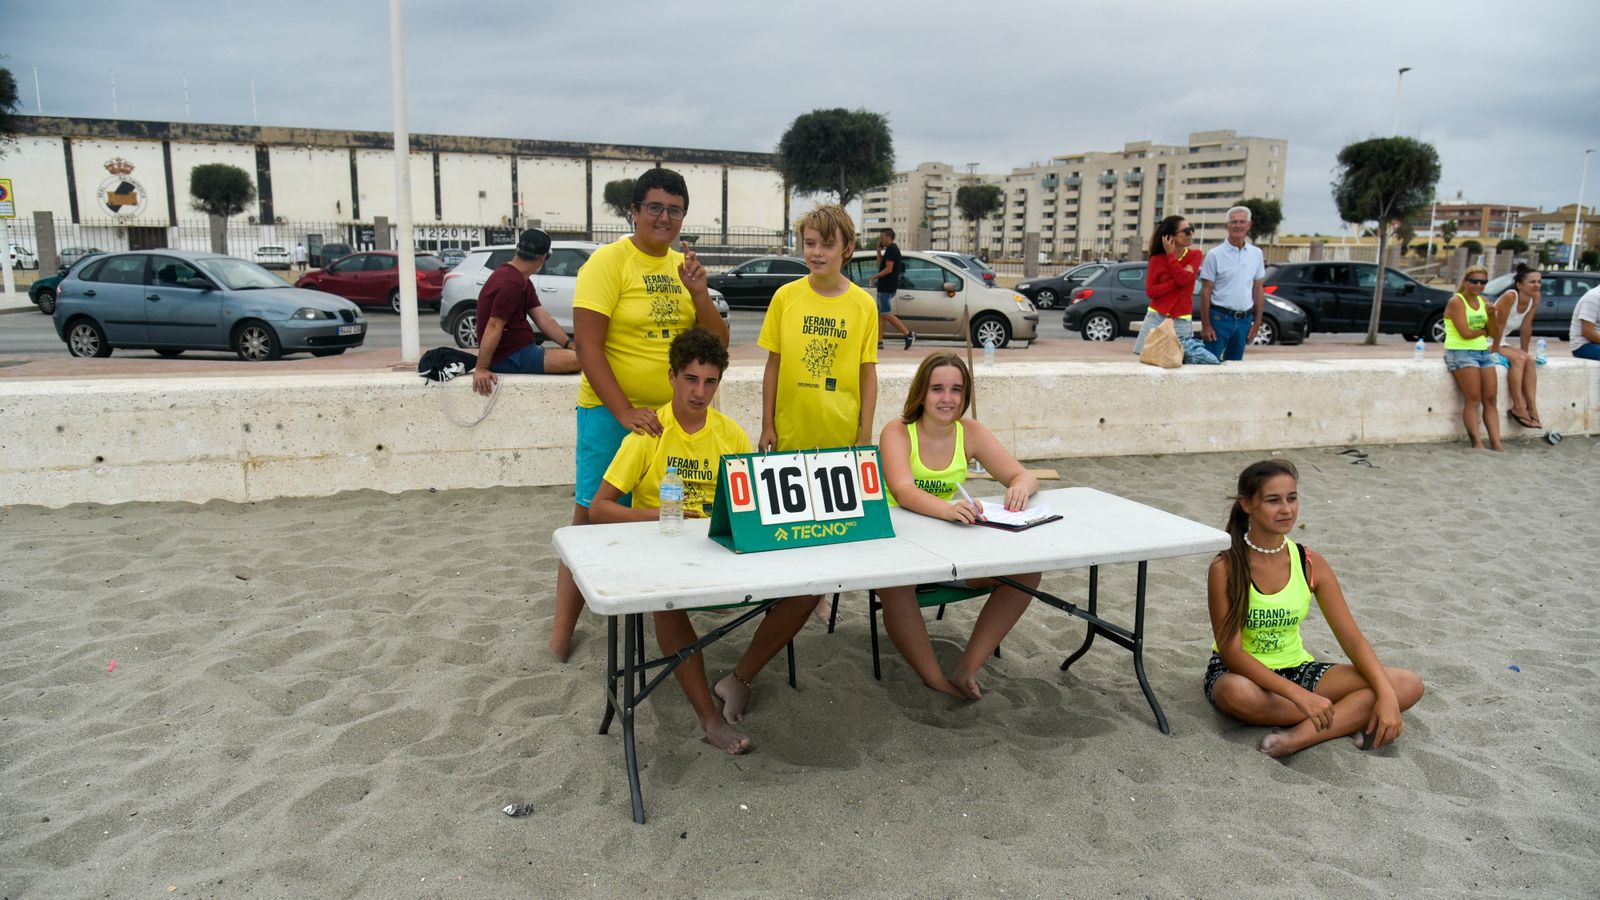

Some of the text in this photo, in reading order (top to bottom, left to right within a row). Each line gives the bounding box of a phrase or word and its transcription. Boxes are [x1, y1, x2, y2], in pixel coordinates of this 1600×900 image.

[642, 275, 670, 284] VERANO
[646, 284, 682, 294] DEPORTIVO
[803, 316, 836, 328] VERANO
[803, 325, 847, 339] DEPORTIVO
[667, 456, 699, 469] VERANO
[677, 468, 713, 480] PORTIVO
[730, 461, 879, 515] 0 16 10 0
[914, 479, 942, 488] ERANO
[791, 522, 847, 539] TECNO
[1247, 608, 1285, 620] VERANO
[1246, 616, 1299, 628] DEPORTIVO
